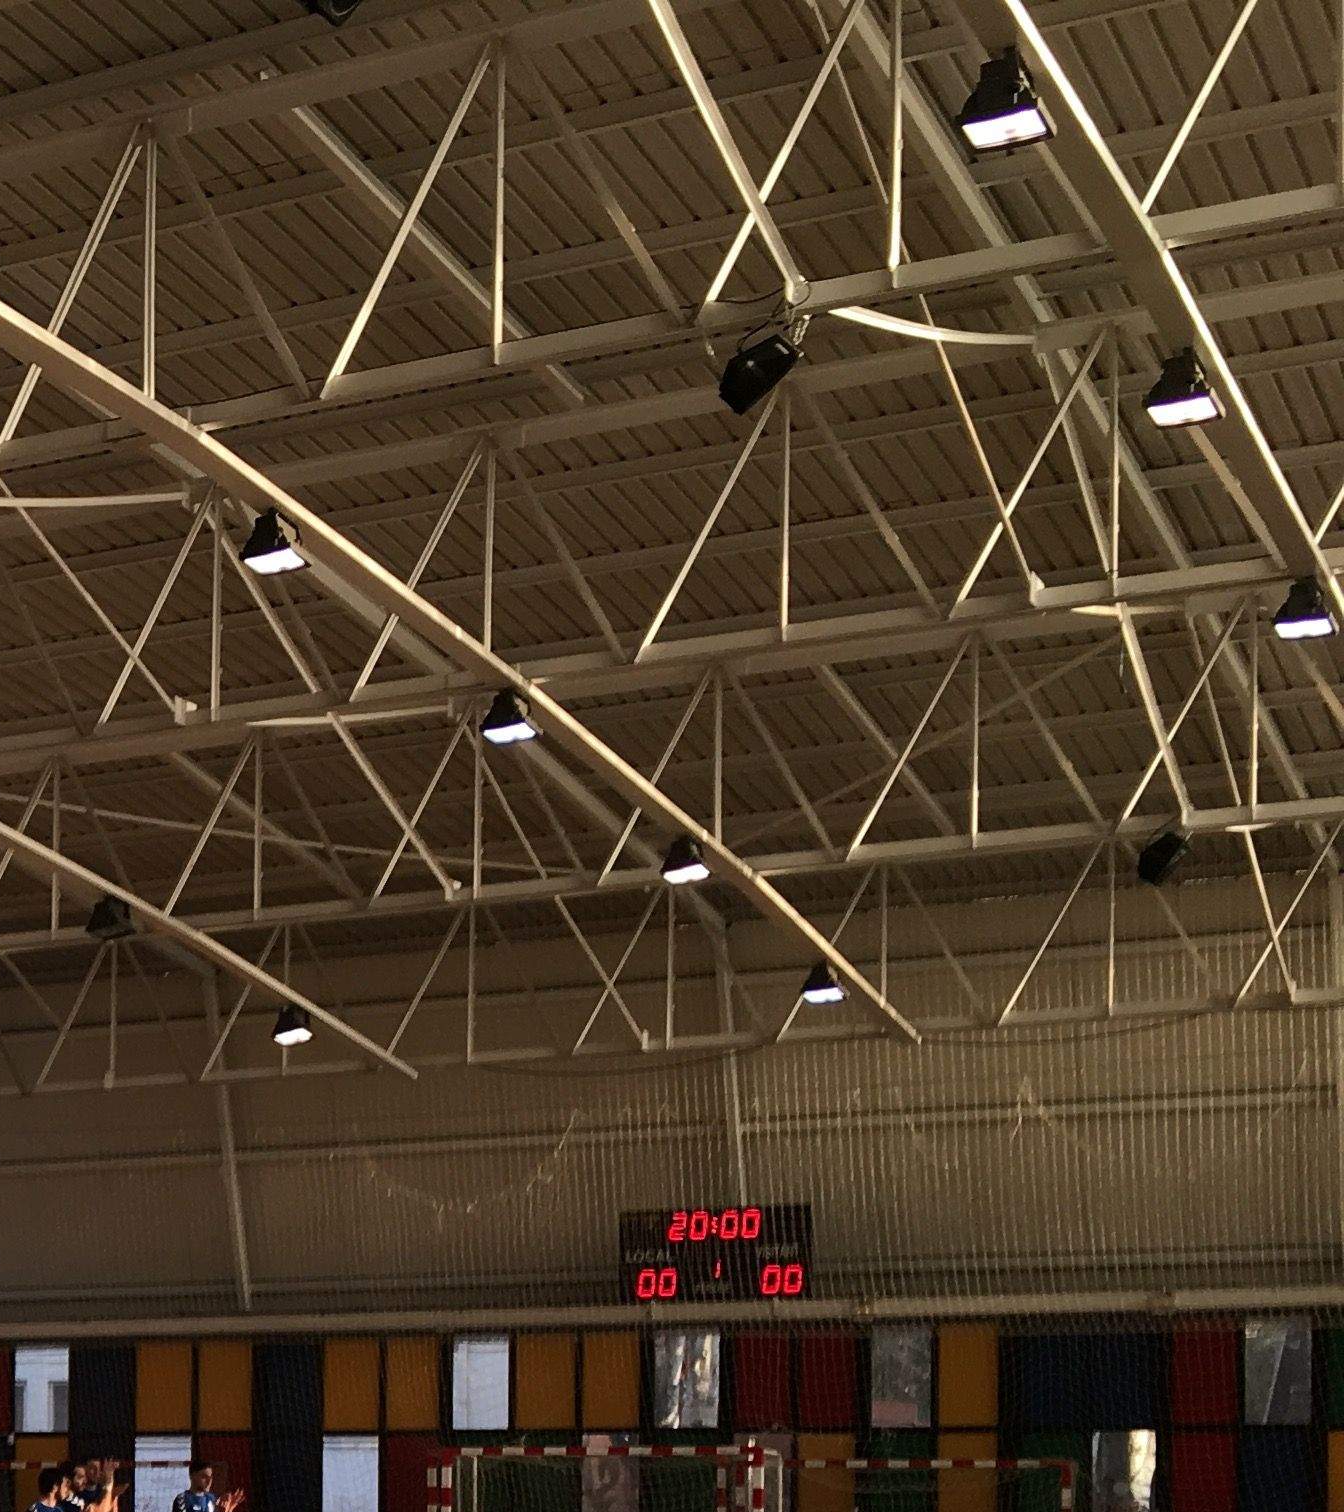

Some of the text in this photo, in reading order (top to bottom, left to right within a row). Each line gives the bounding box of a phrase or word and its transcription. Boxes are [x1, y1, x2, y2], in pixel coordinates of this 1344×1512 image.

[666, 1207, 762, 1242] 20:00
[625, 1248, 673, 1264] LOCAL
[636, 1267, 678, 1299] 00
[760, 1263, 804, 1295] 00
